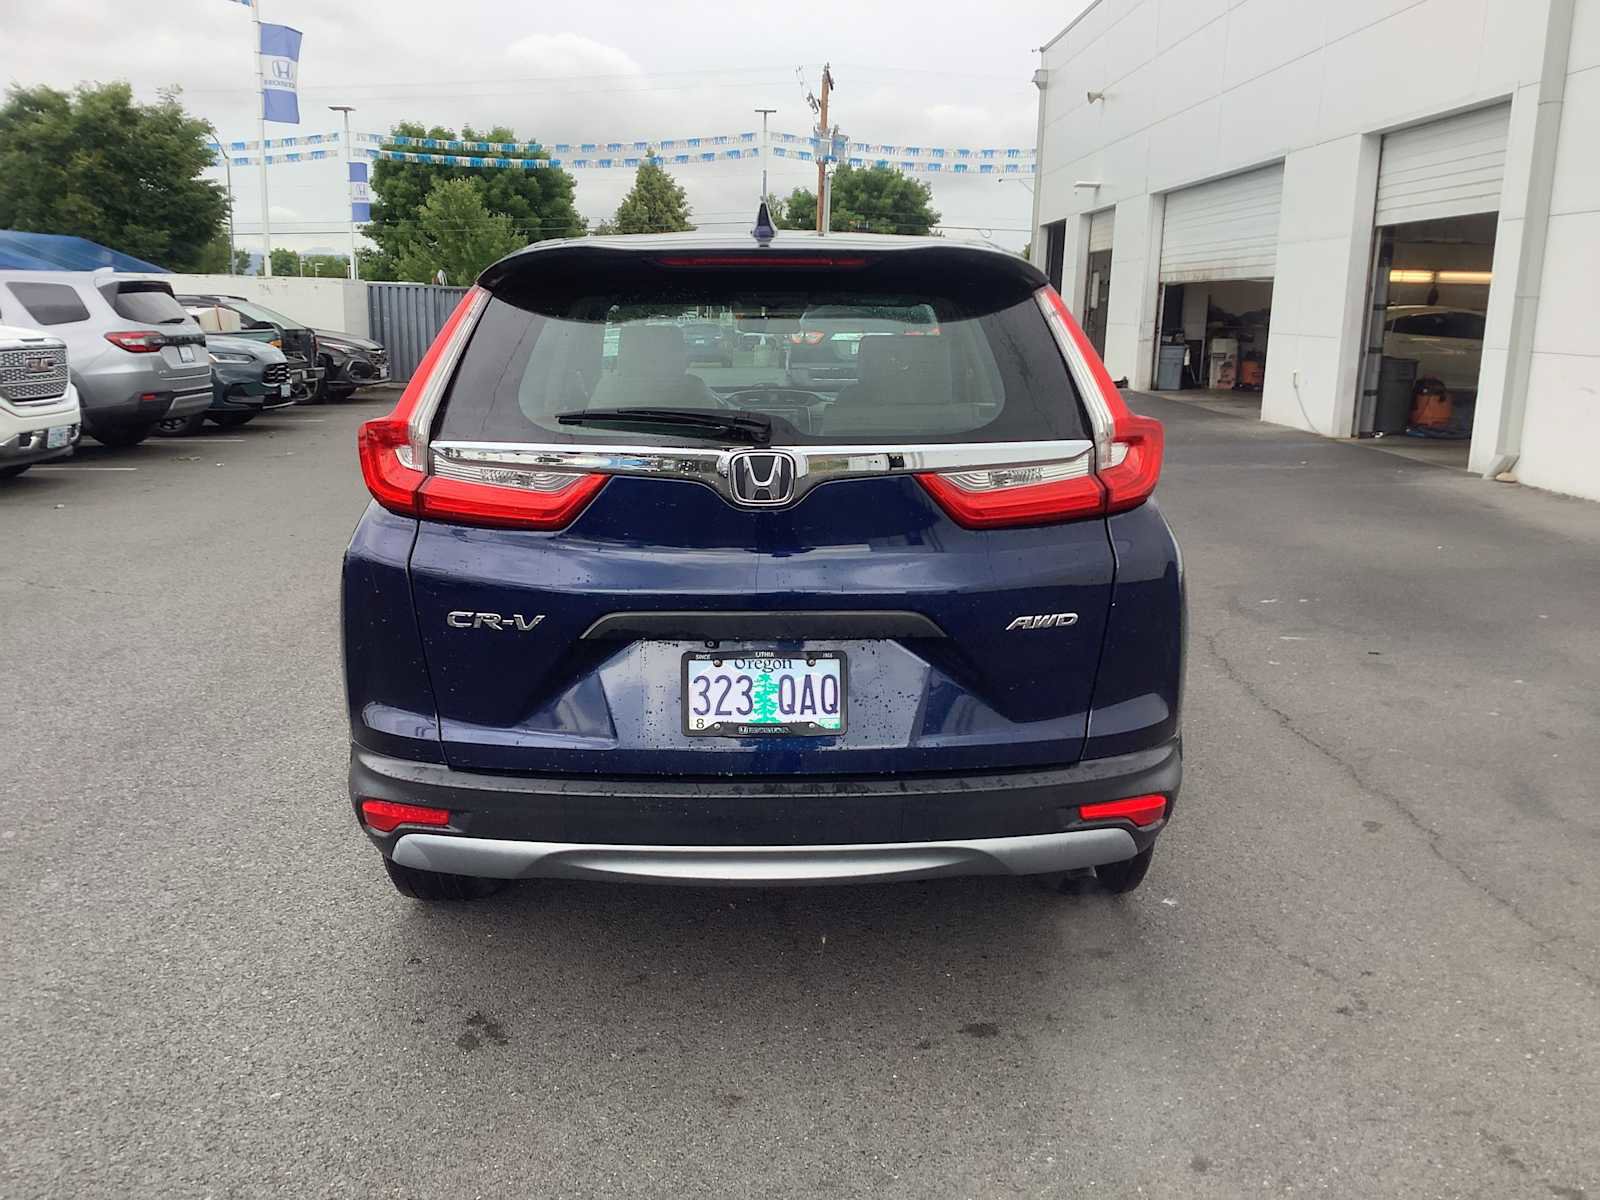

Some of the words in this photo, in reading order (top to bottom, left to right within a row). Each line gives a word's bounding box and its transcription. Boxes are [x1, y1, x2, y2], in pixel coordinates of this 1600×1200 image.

[447, 611, 546, 631] CR-V
[1005, 612, 1079, 631] AWD
[734, 659, 793, 673] Oregon
[693, 674, 753, 716] 323
[778, 674, 839, 715] QAQ
[695, 718, 705, 729] 8
